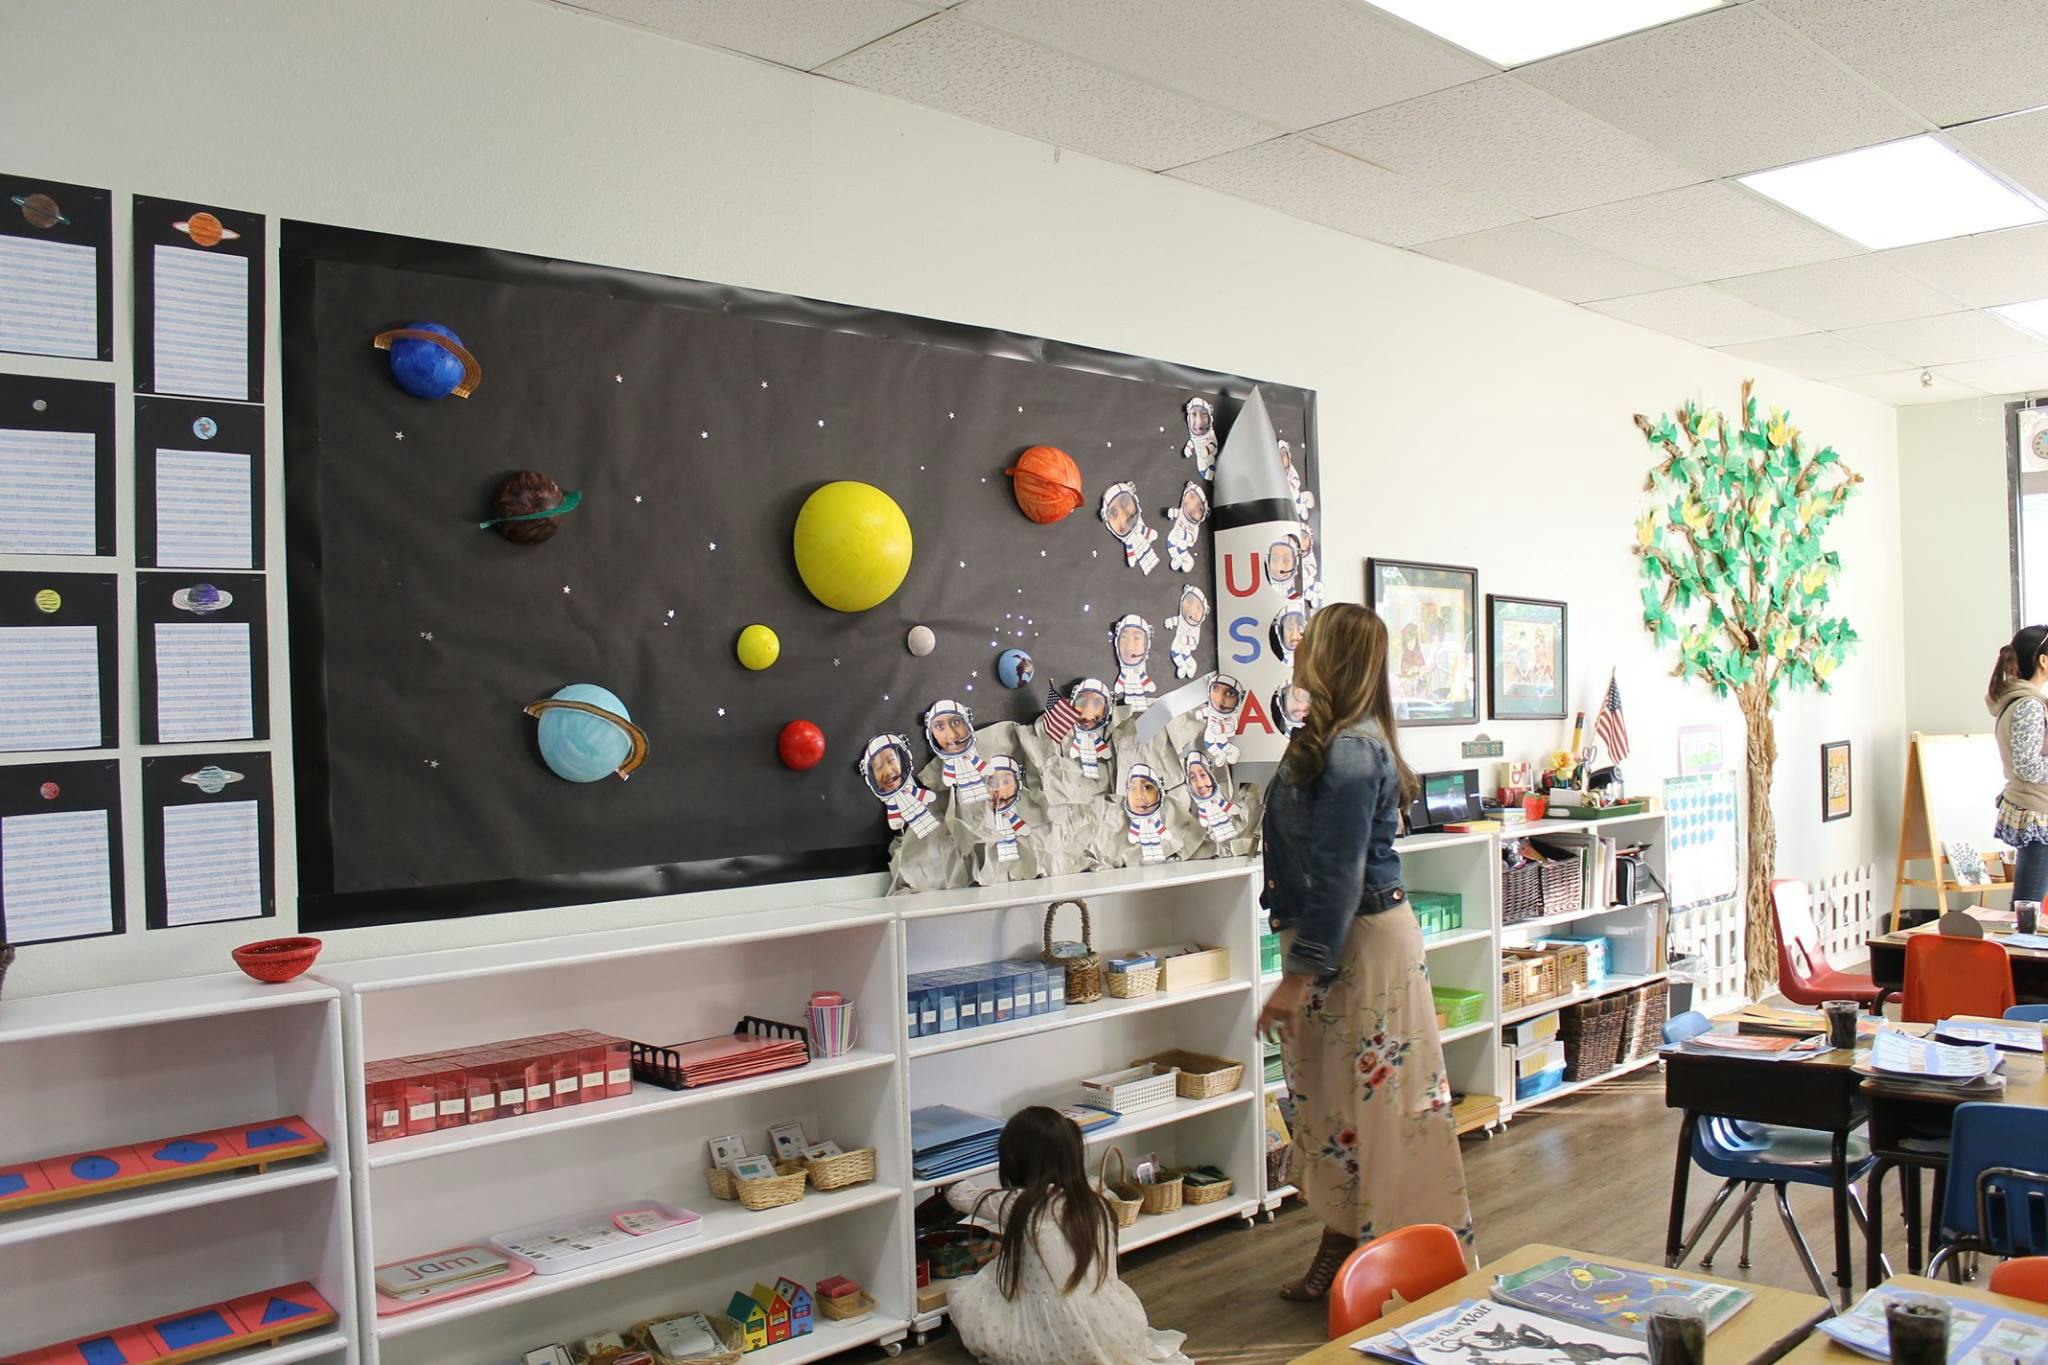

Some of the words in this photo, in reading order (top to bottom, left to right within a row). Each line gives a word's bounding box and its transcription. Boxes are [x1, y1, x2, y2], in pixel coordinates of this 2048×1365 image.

[403, 1256, 480, 1282] jam
[1440, 1326, 1464, 1337] the
[1457, 1303, 1493, 1326] Wolf
